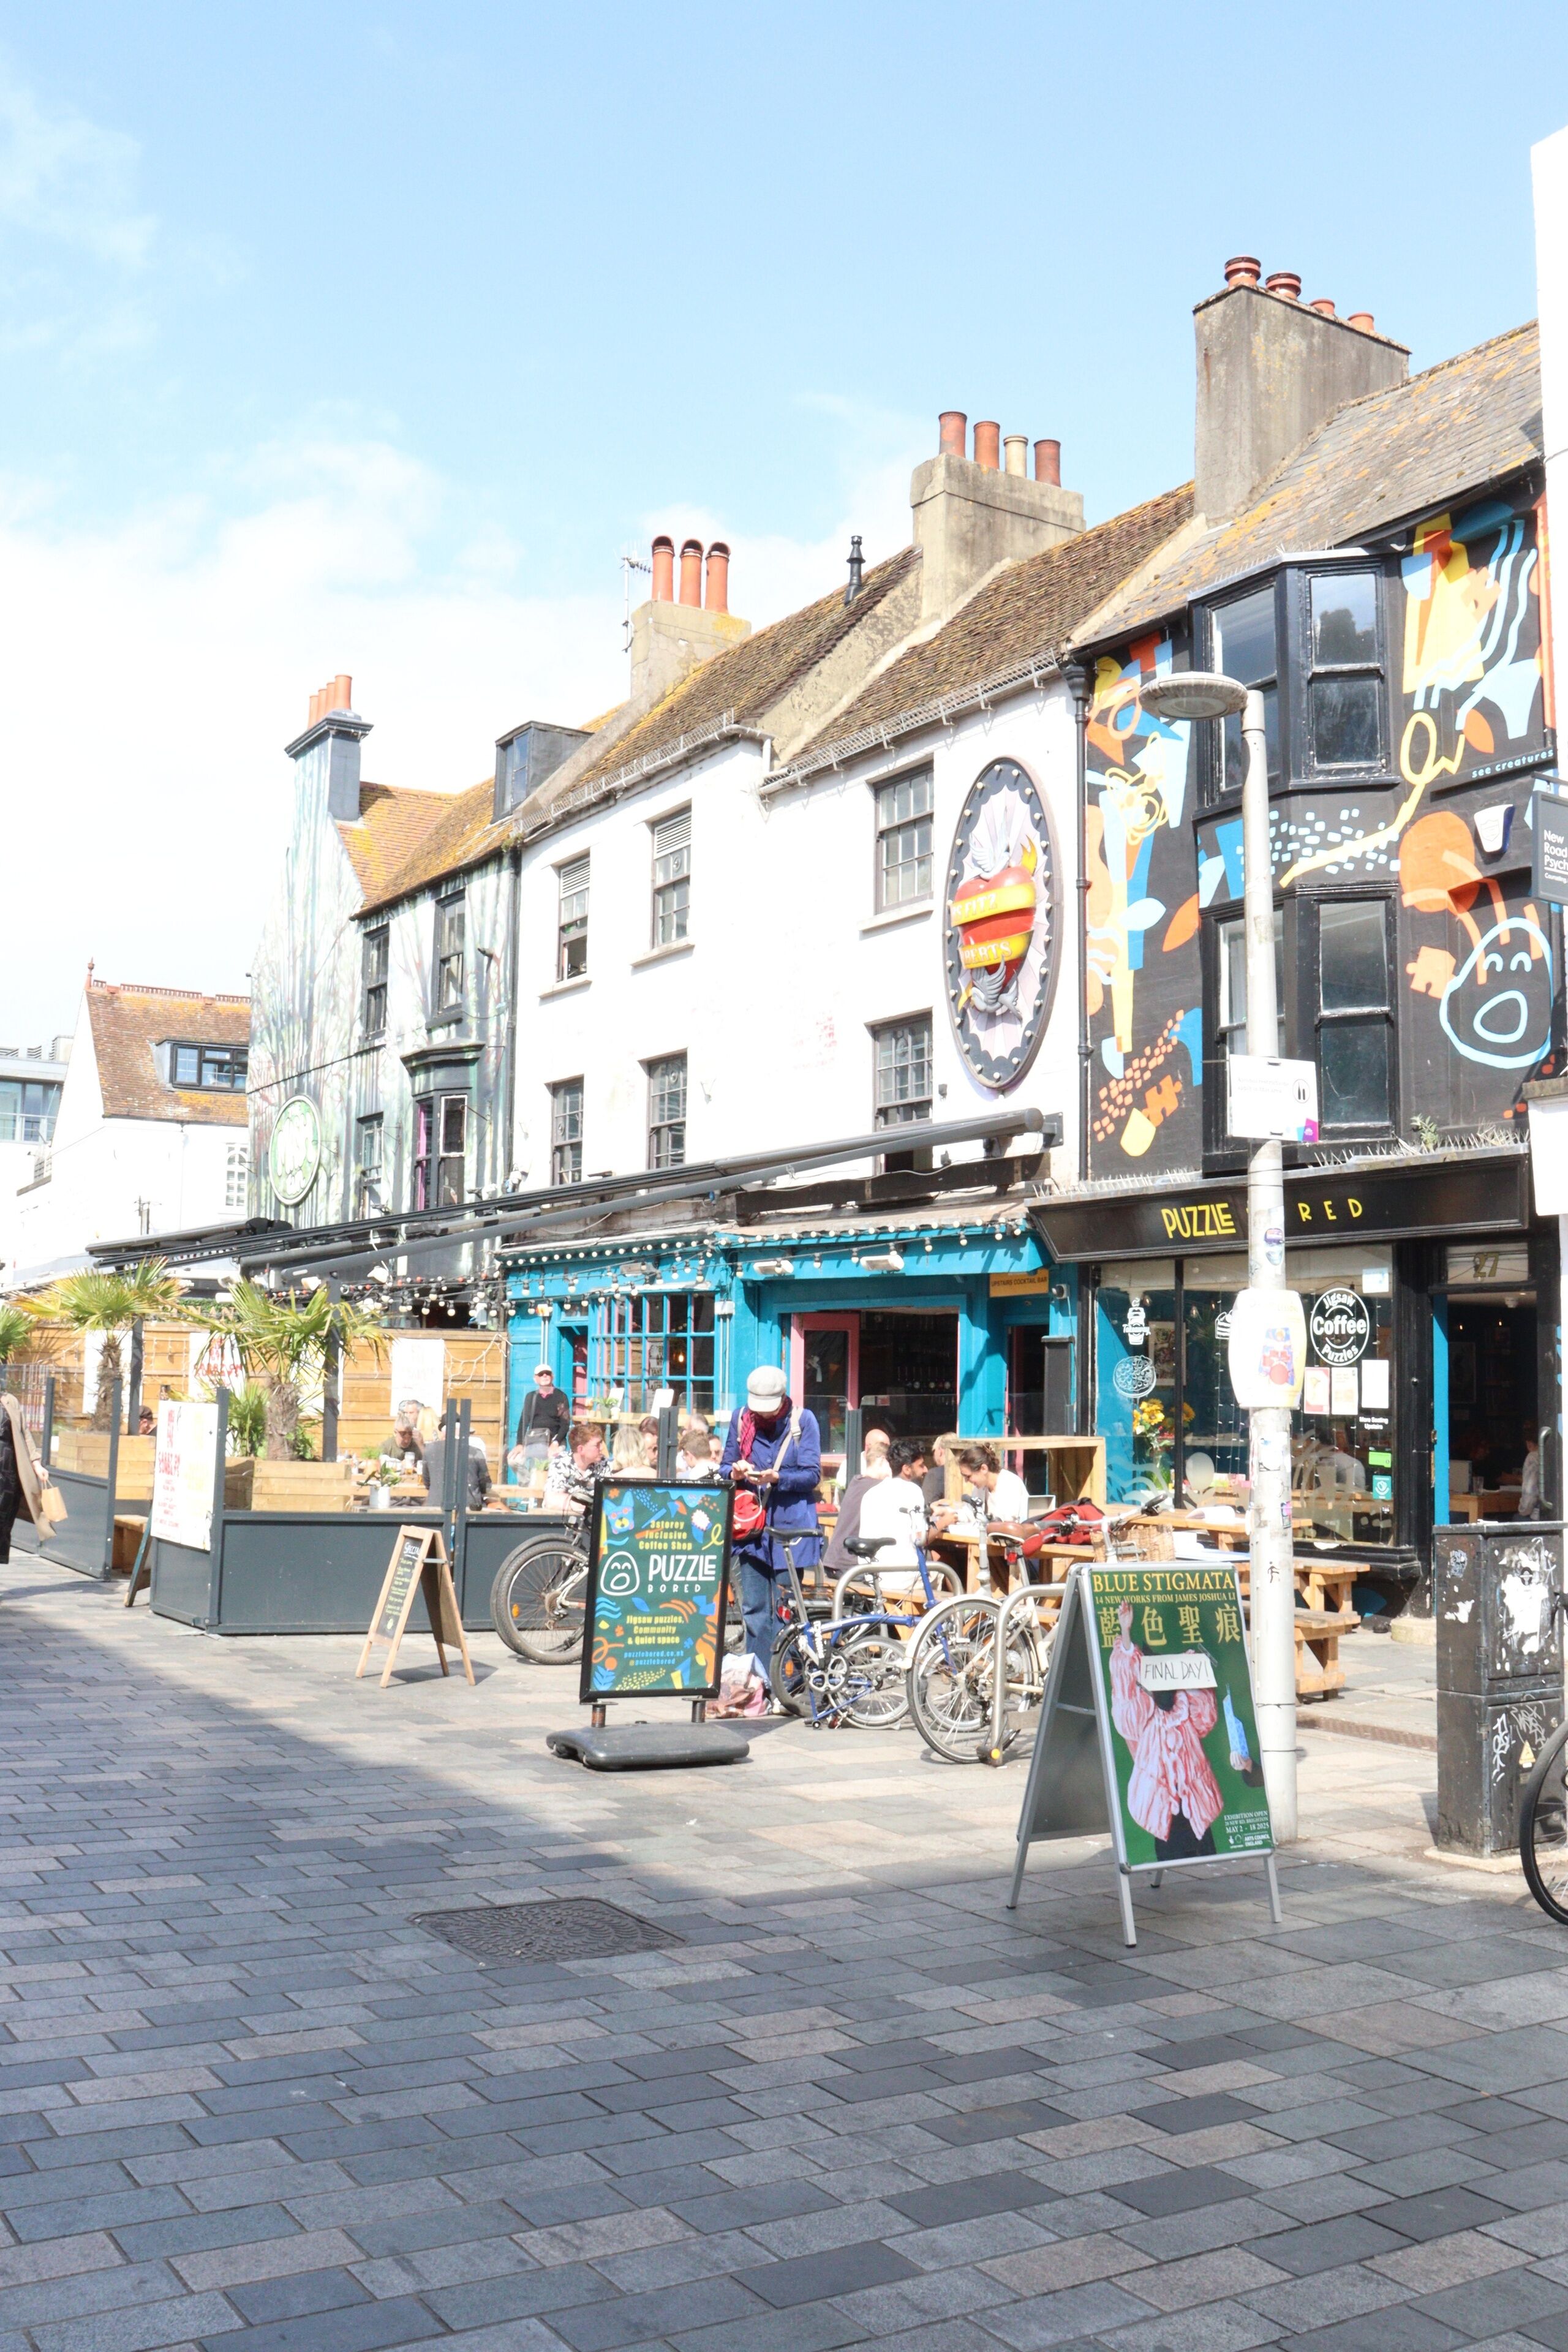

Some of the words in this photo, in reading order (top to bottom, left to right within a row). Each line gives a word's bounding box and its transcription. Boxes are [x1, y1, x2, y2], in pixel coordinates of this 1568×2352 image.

[1472, 767, 1491, 778] see
[1495, 748, 1554, 772] creatures
[1544, 829, 1564, 844] New
[1544, 842, 1568, 858] Road
[1161, 1202, 1236, 1238] PUZZLE
[1246, 1199, 1363, 1222] RED
[1473, 1251, 1499, 1278] 27
[1323, 1293, 1355, 1310] Jigsaw
[1313, 1315, 1366, 1335] Coffee
[1321, 1343, 1359, 1362] Puzzles
[650, 1520, 685, 1530] 3storey
[639, 1541, 668, 1550] Coffee
[671, 1541, 692, 1551] Shop
[649, 1554, 717, 1581] PUZZLE
[648, 1584, 701, 1593] BORED
[1093, 1574, 1139, 1593] BLUE
[1144, 1571, 1235, 1591] STIGMATA
[1104, 1595, 1122, 1604] NEW
[1123, 1594, 1150, 1604] WORKS
[1152, 1594, 1174, 1603] FROM
[1175, 1593, 1198, 1603] JAMES
[1199, 1592, 1226, 1602] JOSHUA
[1227, 1592, 1236, 1600] LI
[626, 1615, 653, 1624] Jigsaw
[633, 1625, 676, 1634] Community
[635, 1635, 655, 1645] Quiet
[657, 1636, 680, 1645] space
[624, 1650, 684, 1659] puzzlebored.co.uk
[1144, 1662, 1178, 1680] FINAL
[1181, 1660, 1211, 1682] DAY!
[1224, 1812, 1254, 1821] EXHIBITION
